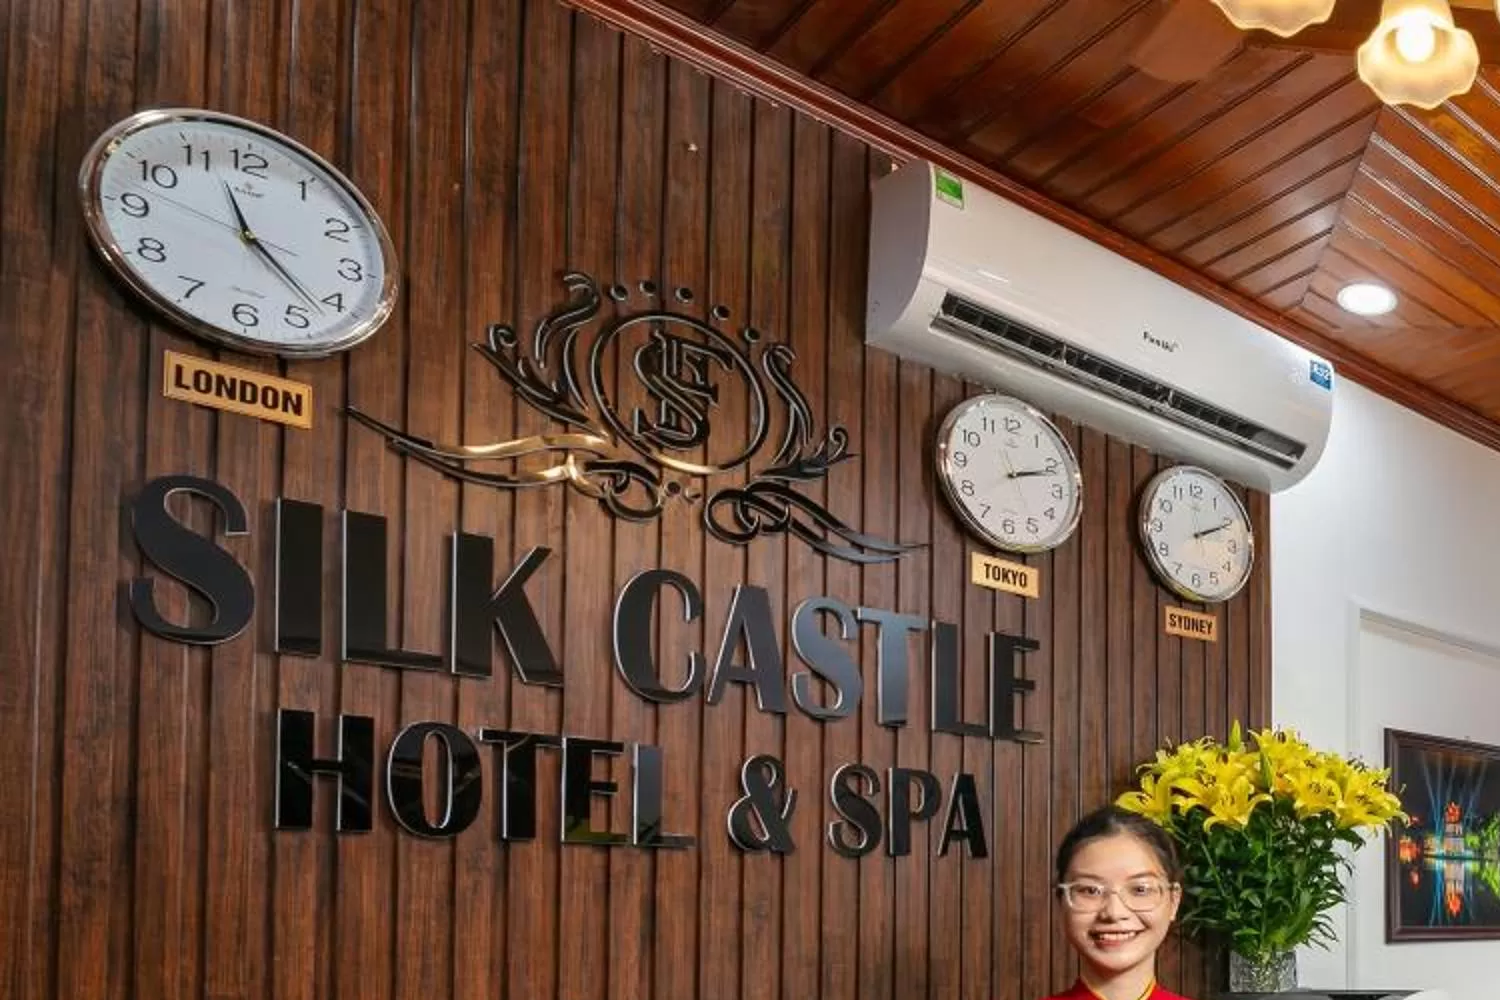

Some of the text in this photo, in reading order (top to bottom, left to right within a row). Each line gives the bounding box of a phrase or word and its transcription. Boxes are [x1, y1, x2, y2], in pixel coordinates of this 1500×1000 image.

[181, 144, 210, 172] 11
[229, 148, 269, 180] 12
[137, 159, 178, 189] 10
[297, 180, 307, 201] 1
[120, 192, 149, 218] 9
[324, 217, 350, 243] 2
[137, 237, 167, 263] 8
[337, 257, 363, 283] 3
[177, 275, 206, 299] 7
[321, 292, 346, 313] 4
[231, 303, 260, 328] 6
[283, 304, 310, 329] 5
[172, 362, 304, 418] LONDON
[983, 416, 995, 435] 11
[1004, 416, 1021, 434] 12
[963, 428, 981, 447] 10
[1034, 433, 1039, 449] 1
[953, 451, 967, 468] 9
[961, 479, 975, 497] 8
[1051, 483, 1063, 500] 3
[1173, 485, 1183, 500] 11
[1189, 483, 1203, 500] 12
[979, 503, 991, 519] 7
[1160, 497, 1173, 513] 10
[1213, 497, 1217, 511] 1
[1043, 507, 1056, 520] 4
[1002, 518, 1016, 535] 6
[1025, 517, 1039, 534] 5
[1152, 517, 1163, 533] 9
[1159, 542, 1169, 557] 8
[1227, 539, 1237, 555] 3
[983, 562, 1028, 589] TOKYO
[1172, 561, 1182, 575] 7
[1221, 560, 1231, 573] 4
[1191, 573, 1201, 588] 6
[1209, 571, 1219, 585] 5
[129, 473, 1046, 745] SILK CASTLE
[1168, 613, 1214, 635] SYDNEY
[273, 707, 990, 860] HOTEL & SPA
